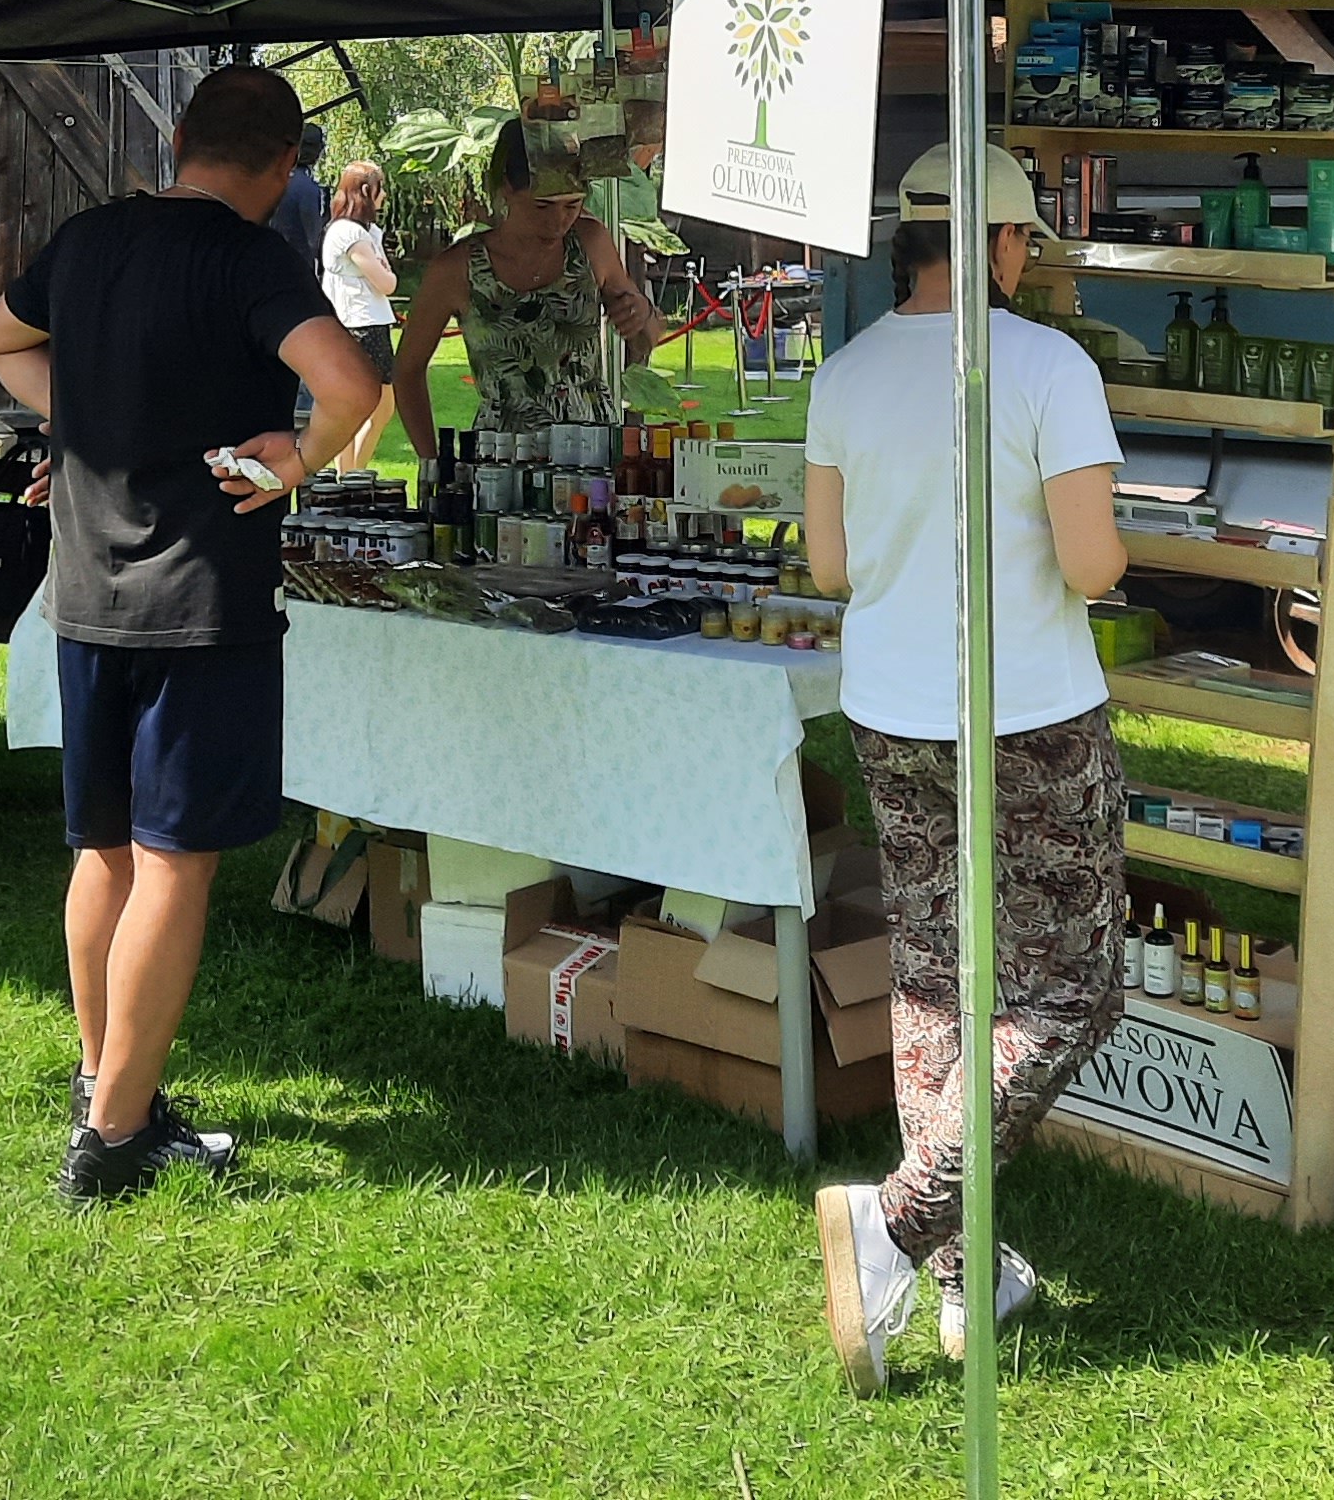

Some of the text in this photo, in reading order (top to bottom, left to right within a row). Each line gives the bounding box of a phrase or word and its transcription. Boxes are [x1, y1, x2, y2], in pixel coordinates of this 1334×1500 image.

[727, 146, 794, 176] PREZESOWA
[712, 163, 807, 209] OLIWOWA
[1105, 1022, 1220, 1081] ESOWA
